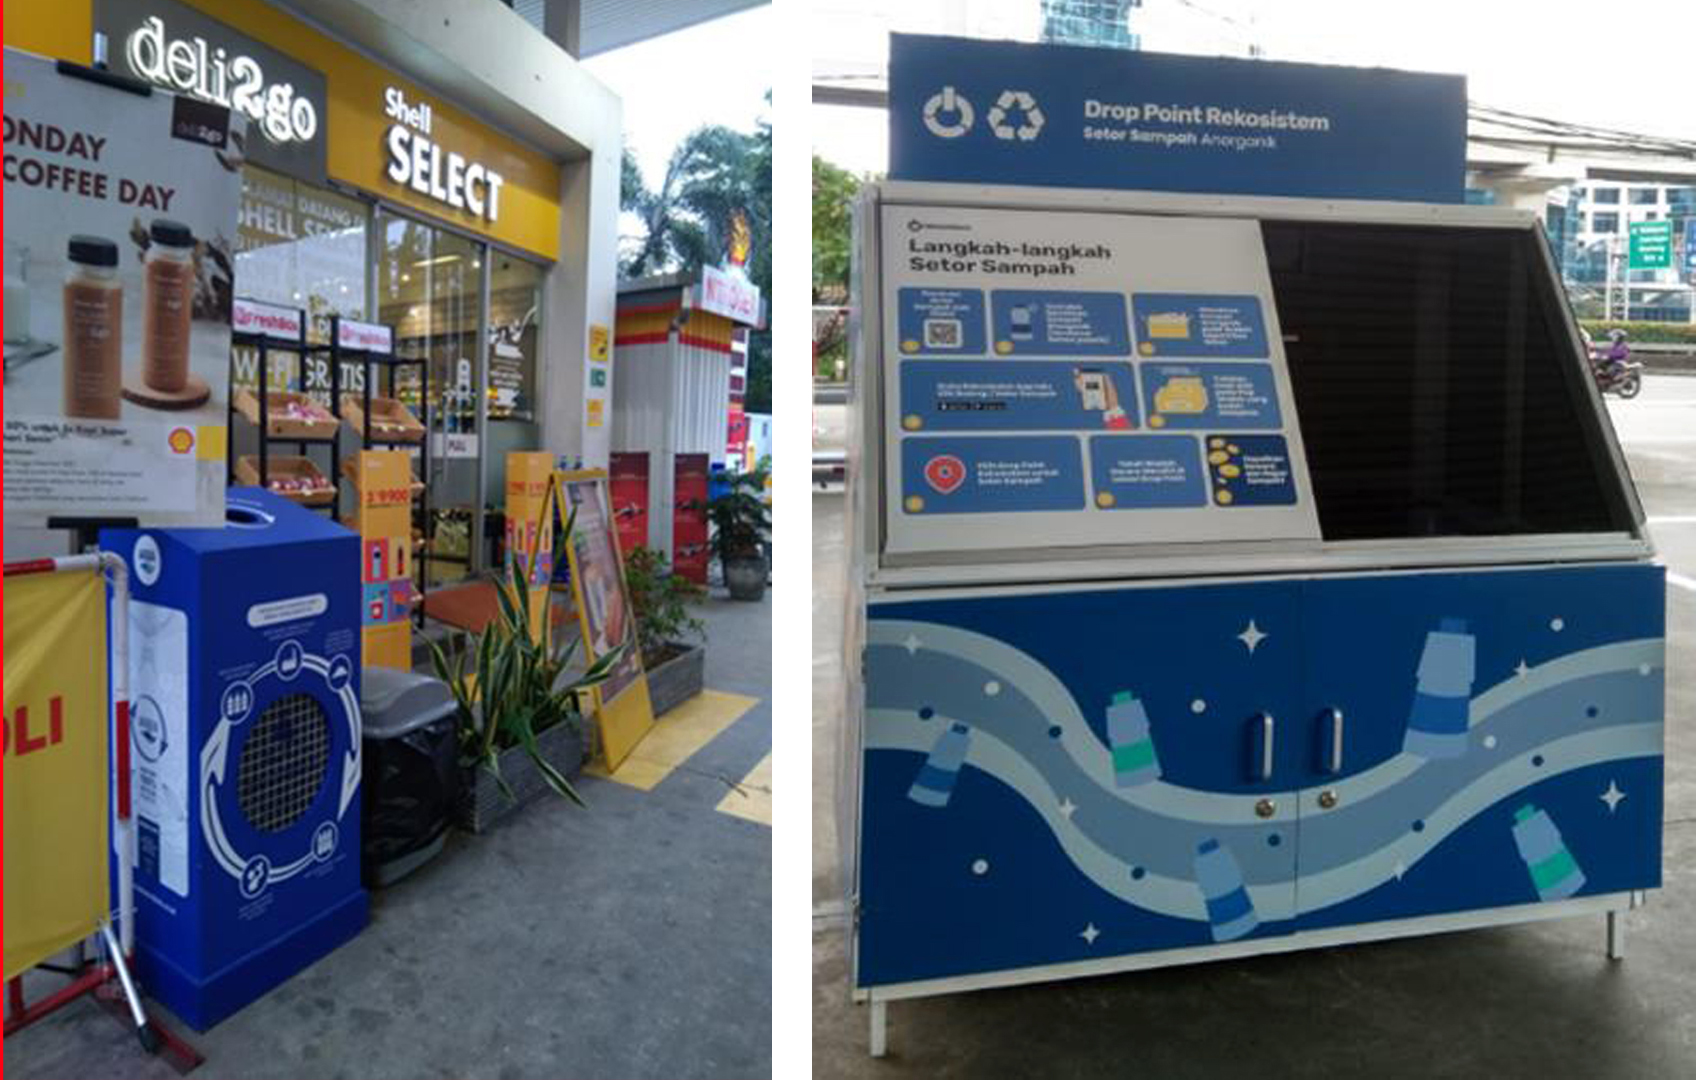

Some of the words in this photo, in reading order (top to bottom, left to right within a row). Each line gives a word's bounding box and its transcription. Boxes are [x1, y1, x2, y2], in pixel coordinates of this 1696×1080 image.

[128, 16, 318, 143] deli2go
[385, 87, 431, 133] Shell
[1084, 100, 1140, 125] Drop
[1144, 104, 1202, 125] Point
[1207, 107, 1330, 131] Rekosistem
[1083, 127, 1128, 141] Setor
[3, 154, 107, 199] COFFEE
[118, 178, 176, 212] DAY
[387, 124, 503, 222] SELECT
[908, 238, 1112, 260] Langkah-langkah
[909, 257, 977, 273] Setor
[981, 259, 1076, 277] Sampah
